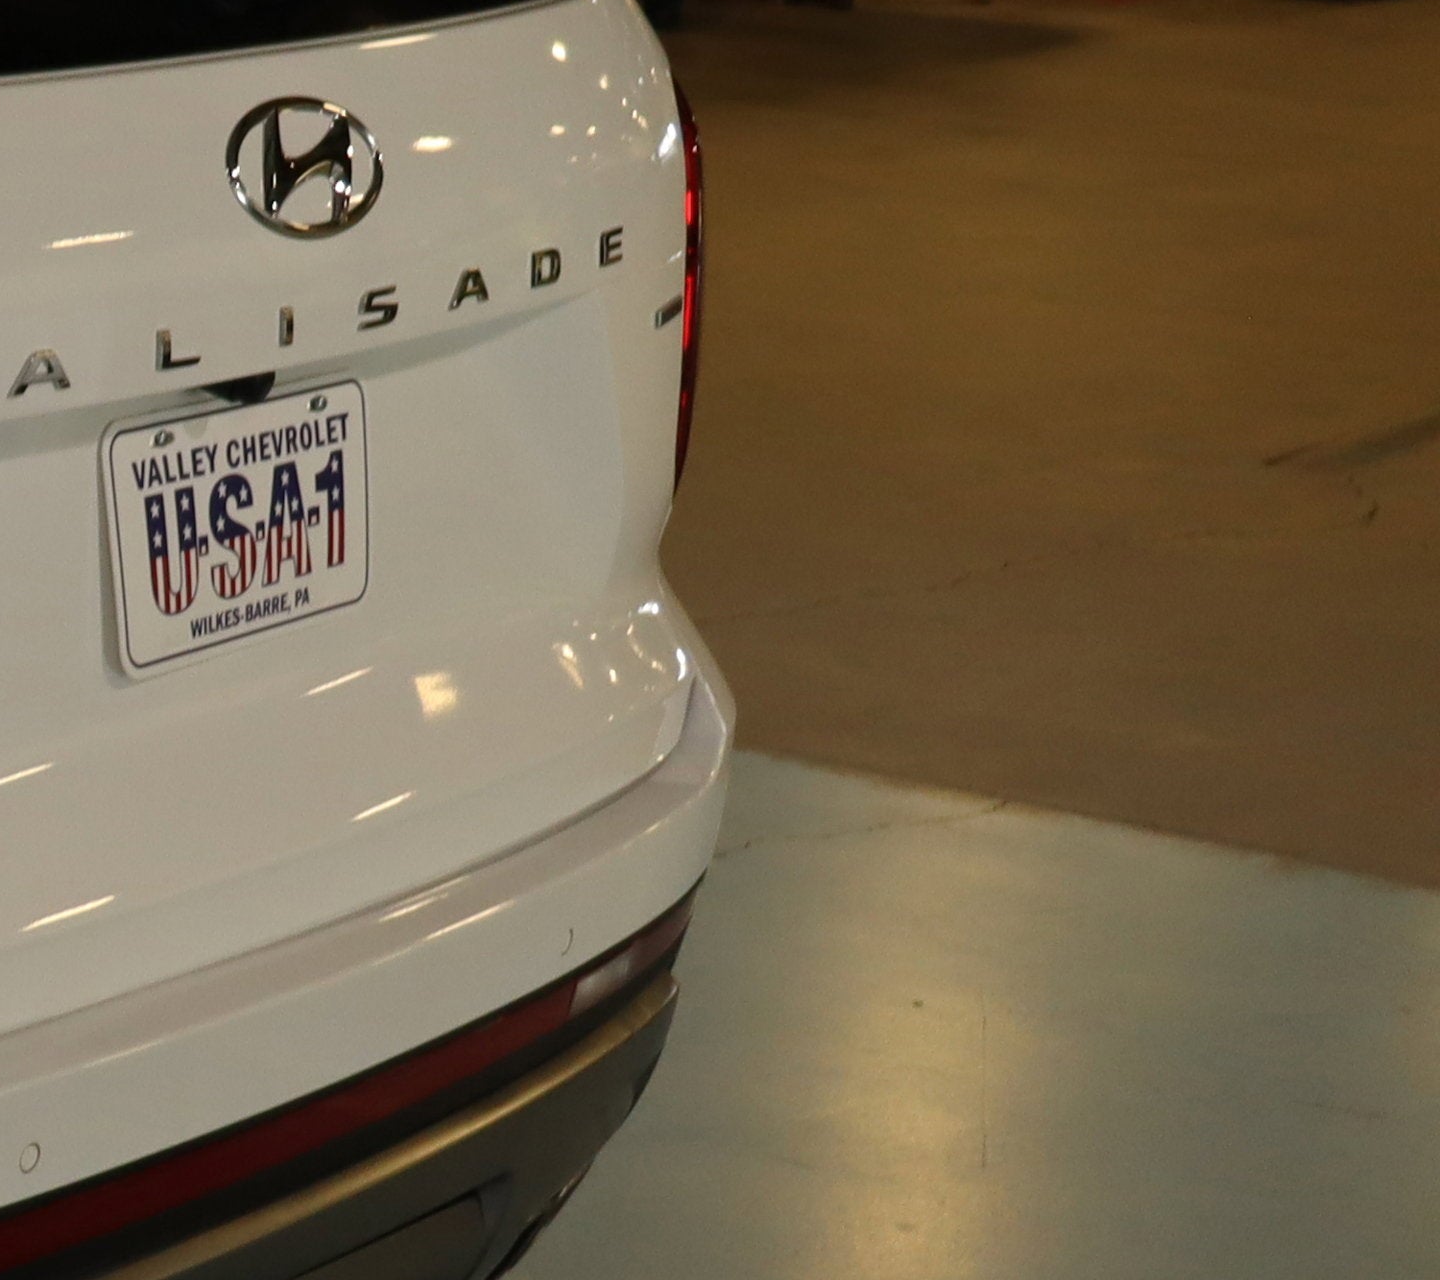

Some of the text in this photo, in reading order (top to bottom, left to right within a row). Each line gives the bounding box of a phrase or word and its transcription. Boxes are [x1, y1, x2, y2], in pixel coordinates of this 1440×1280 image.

[131, 412, 350, 490] VALLEY CHEVROLET
[293, 586, 310, 608] PA
